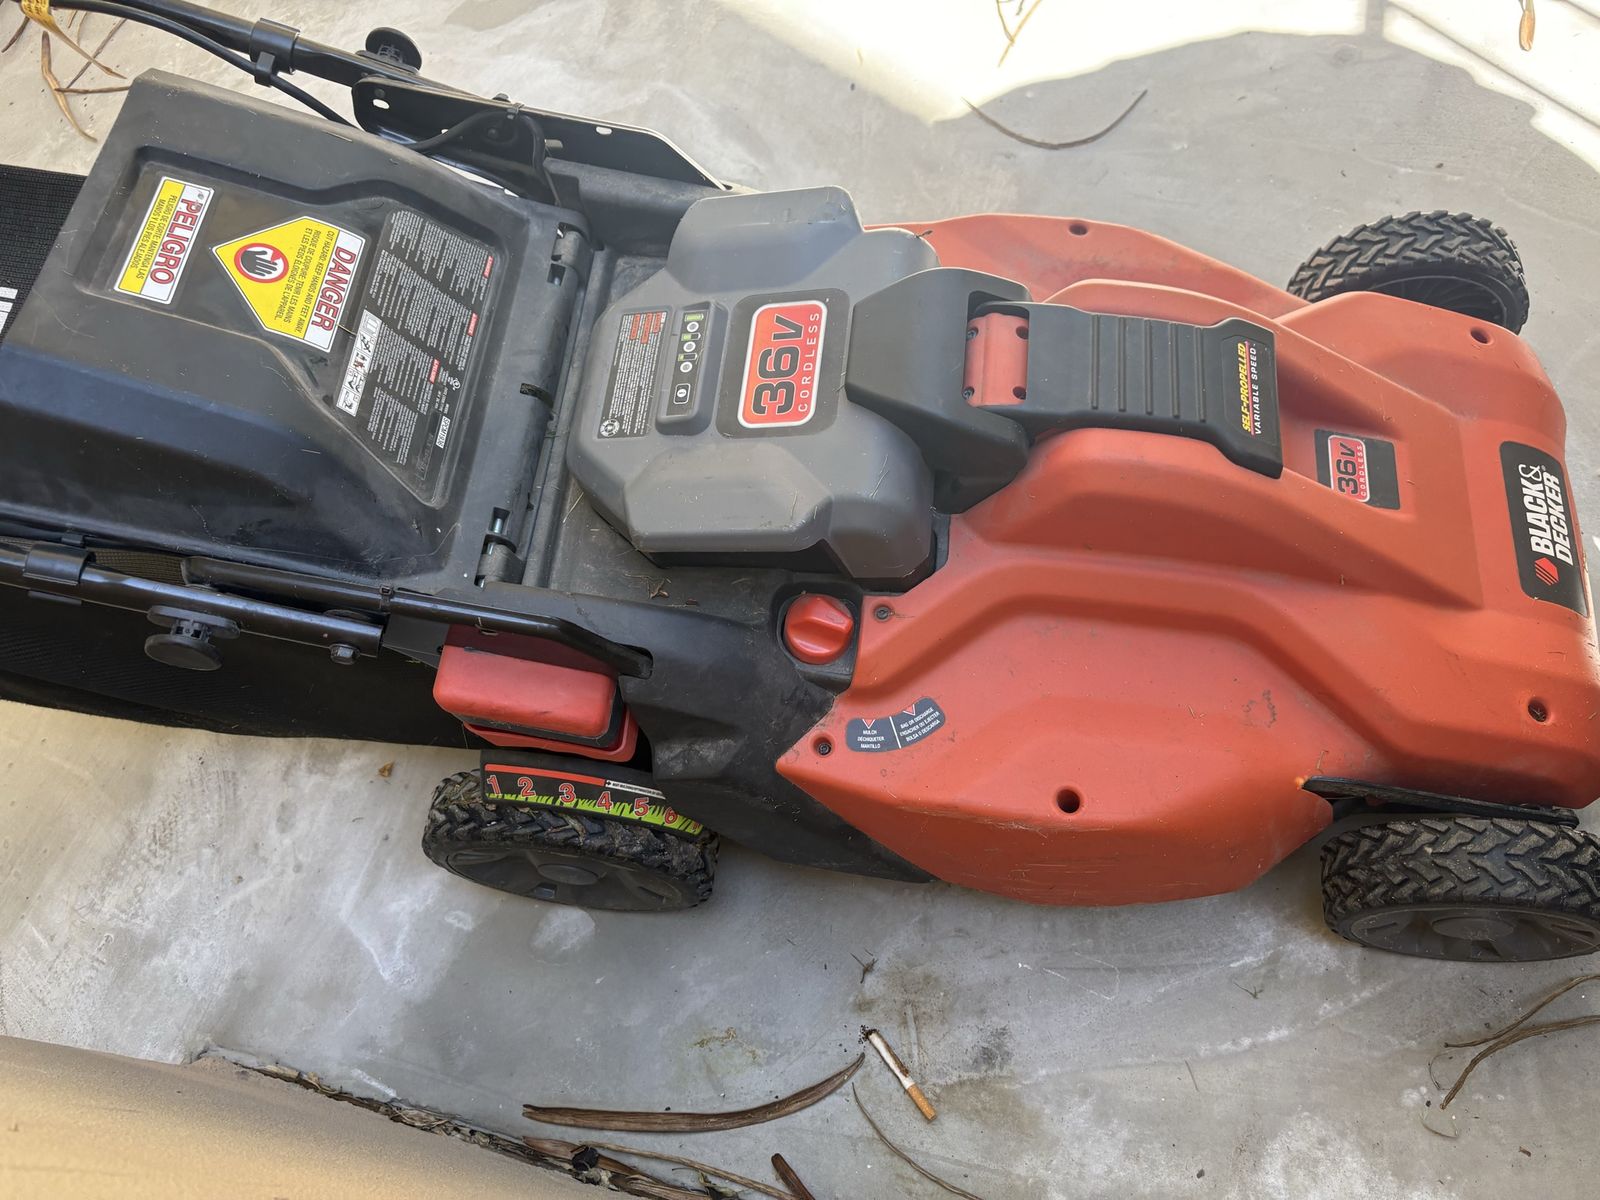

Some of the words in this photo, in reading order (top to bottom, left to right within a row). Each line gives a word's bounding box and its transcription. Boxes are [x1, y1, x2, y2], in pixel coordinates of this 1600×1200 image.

[152, 198, 166, 217] MANOS
[162, 194, 177, 215] PELIGRO
[146, 220, 156, 231] LOS
[159, 214, 169, 223] DE
[141, 230, 152, 243] PIES
[148, 198, 203, 286] PELIGRO
[301, 234, 310, 244] LES
[309, 229, 321, 248] RISQUE
[326, 230, 334, 240] CUT
[140, 240, 158, 268] MANTENGA
[295, 243, 306, 259] PIEDS
[306, 247, 315, 255] DE
[135, 267, 147, 279] LAS
[314, 261, 324, 275] KEEP
[284, 282, 293, 292] DE
[292, 279, 304, 295] TENIR
[308, 274, 319, 293] HANDS
[310, 245, 356, 332] DANGER
[289, 294, 298, 305] LES
[304, 292, 313, 305] AND
[283, 304, 295, 323] MAINS
[299, 304, 309, 318] FEET
[752, 314, 804, 415] 36V
[798, 312, 820, 412] CORDLESS
[1238, 342, 1252, 432] SELF-PROPELLED
[1250, 383, 1262, 435] VARIABLE
[1336, 442, 1359, 495] 36V
[1356, 445, 1368, 500] CORDLESS
[1543, 470, 1574, 566] DECKER
[487, 774, 502, 796] 1
[517, 776, 536, 798] 2
[558, 782, 576, 803] 3
[596, 792, 613, 811] 4
[634, 797, 650, 818] 5
[664, 806, 679, 825] 6
